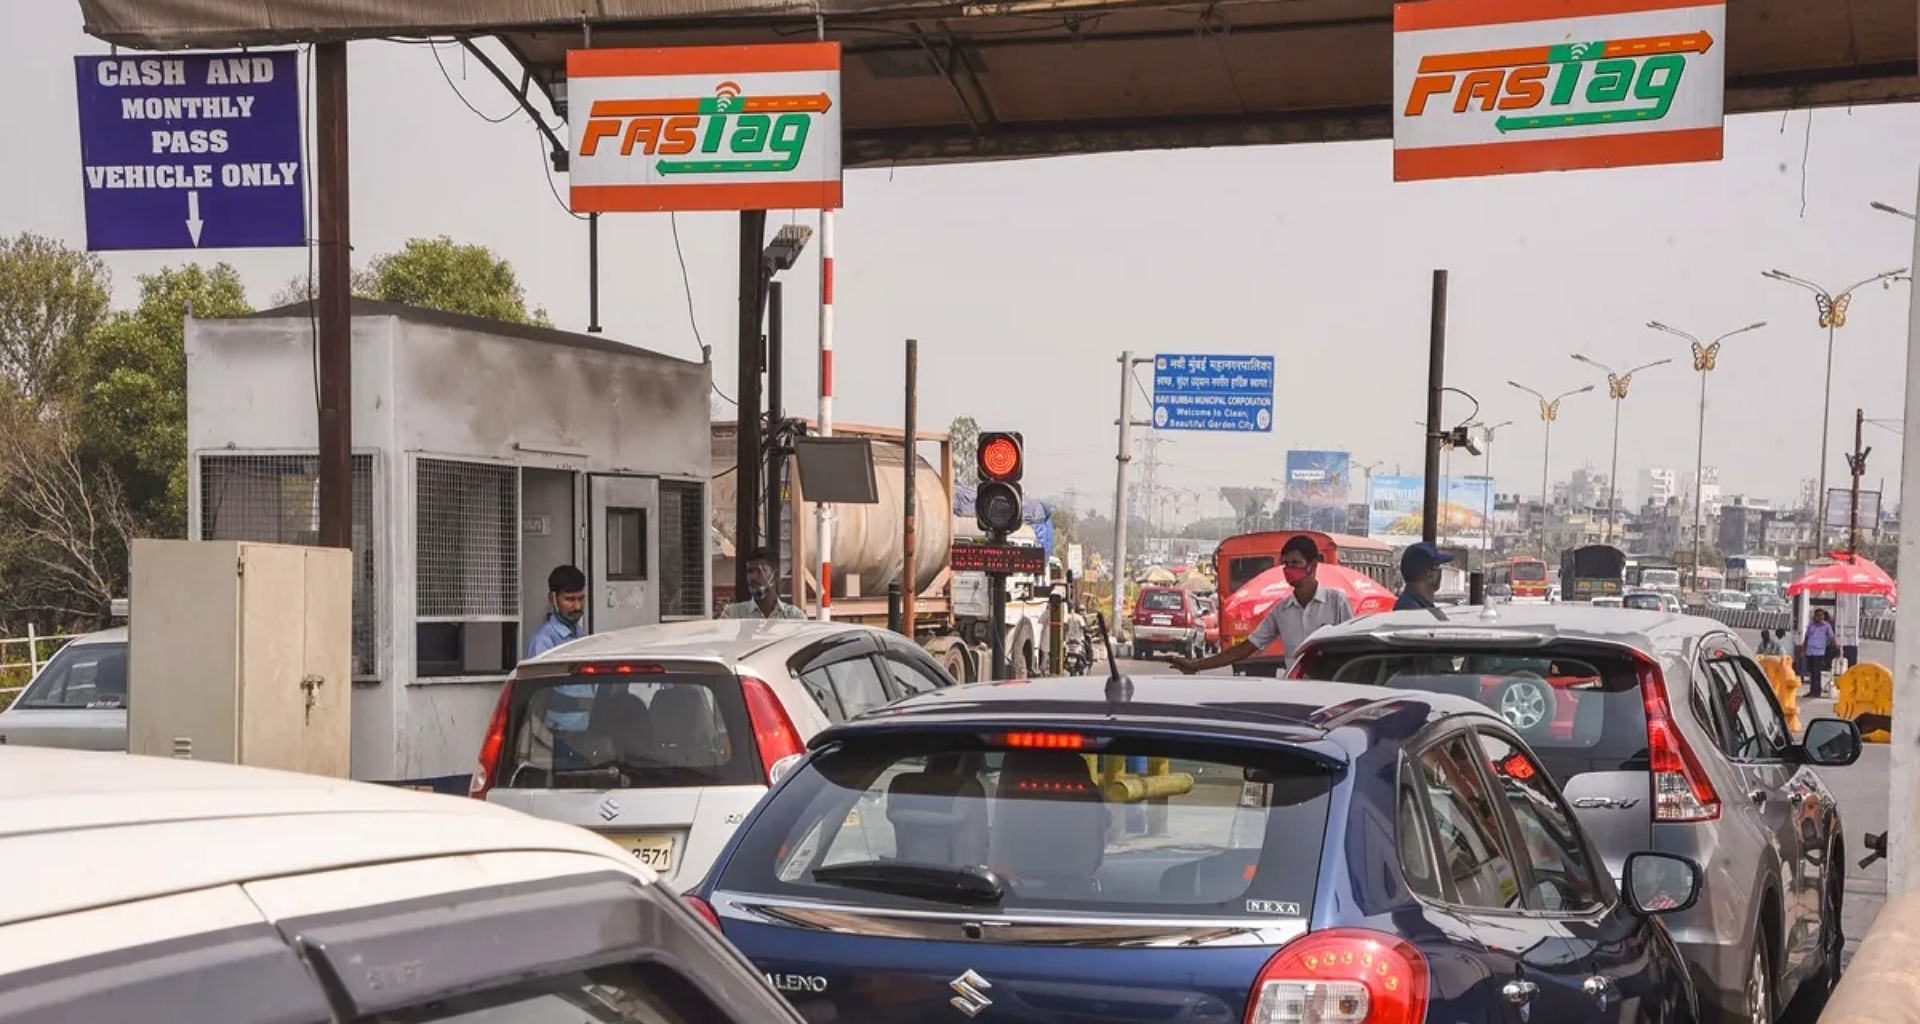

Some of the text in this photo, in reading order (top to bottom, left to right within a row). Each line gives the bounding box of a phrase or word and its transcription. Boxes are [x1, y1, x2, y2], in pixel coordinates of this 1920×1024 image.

[97, 57, 275, 87] CASH AND
[121, 96, 255, 120] MONTHLY
[151, 129, 229, 154] PASS
[86, 162, 298, 188] VEHICLE ONLY
[1227, 396, 1271, 407] CORPORATION
[1176, 408, 1212, 417] Welcome
[1223, 408, 1249, 419] Clean,
[1169, 419, 1255, 431] Beautiful Garden City
[1572, 797, 1640, 810] CR-V
[1251, 901, 1296, 914] NEXA
[764, 972, 828, 993] LENO
